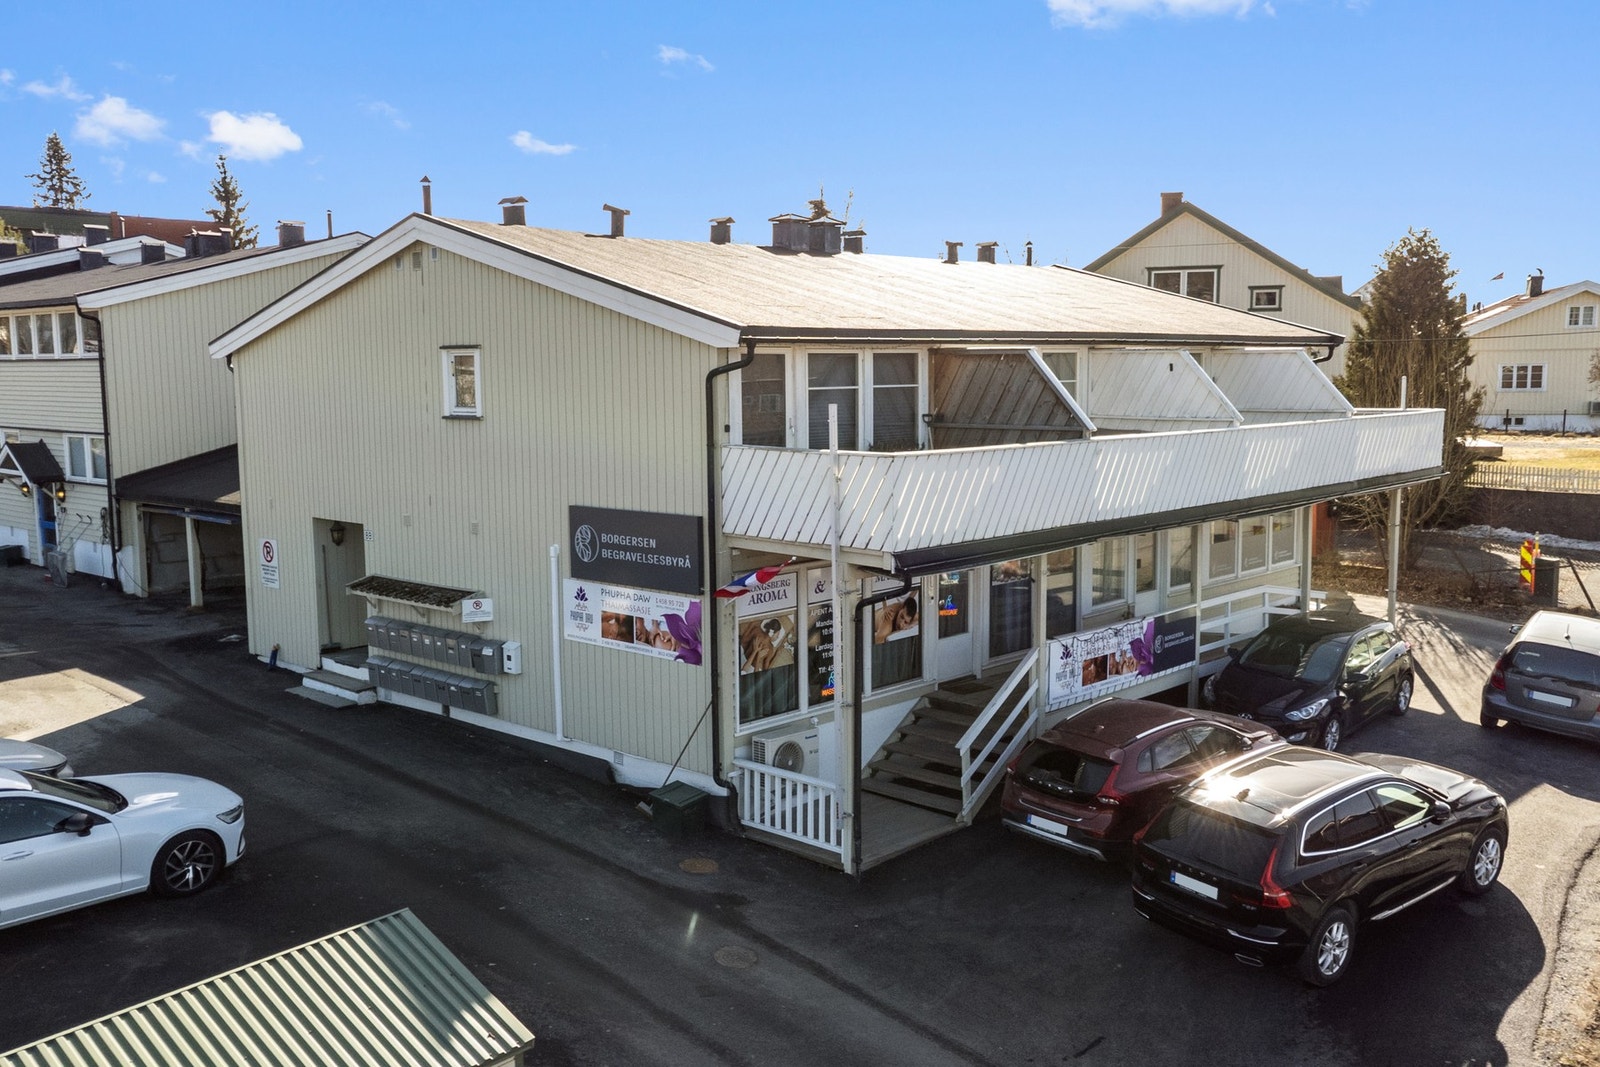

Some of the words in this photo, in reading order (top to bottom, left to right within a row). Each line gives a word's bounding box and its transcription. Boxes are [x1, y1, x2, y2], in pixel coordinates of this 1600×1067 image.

[601, 533, 656, 549] BORGERSEN
[601, 548, 691, 568] BEGRAVELSESBYRÅ
[750, 578, 791, 592] ONGSBERG
[814, 580, 825, 594] &
[601, 588, 631, 600] PHUPHA
[633, 593, 651, 603] DAW
[748, 589, 788, 606] AROMA
[601, 600, 651, 615] THAIMASSASJE
[815, 619, 833, 627] Manda
